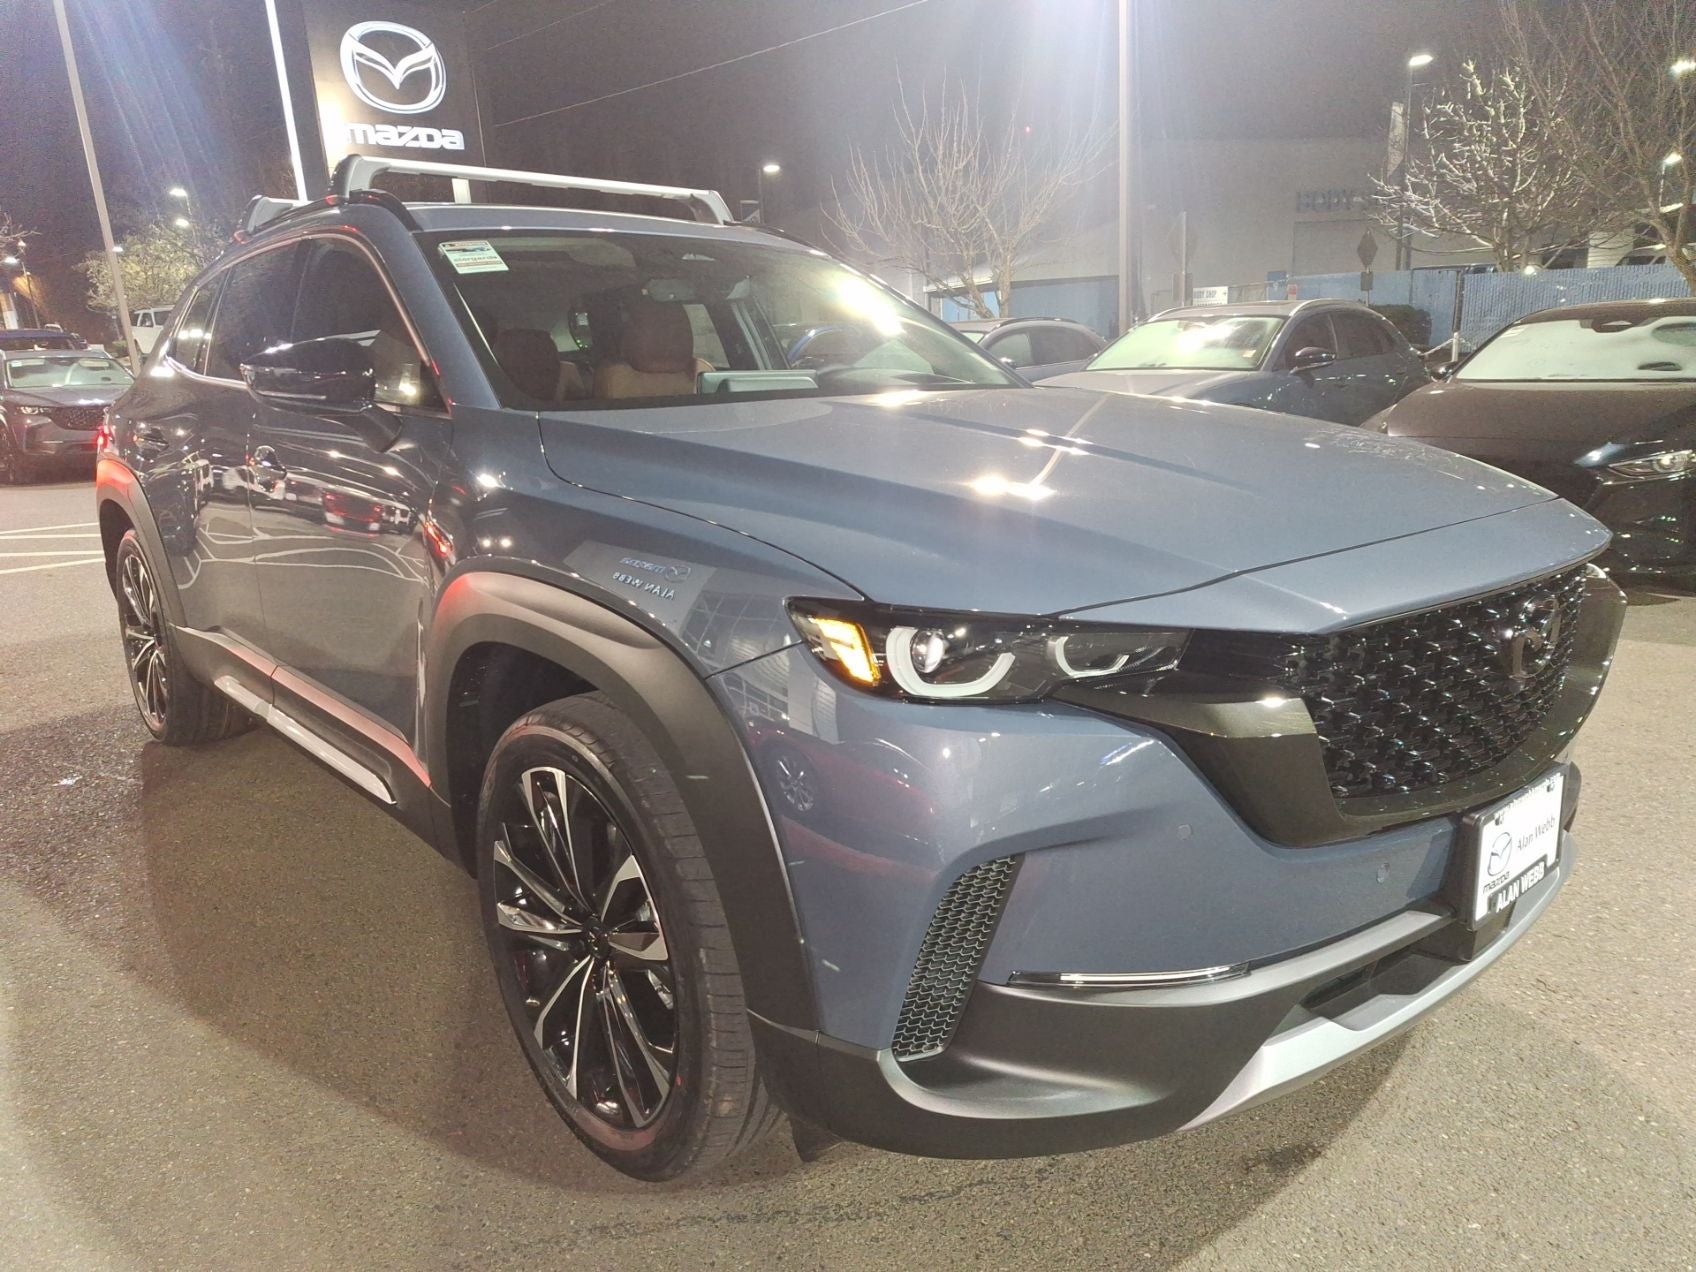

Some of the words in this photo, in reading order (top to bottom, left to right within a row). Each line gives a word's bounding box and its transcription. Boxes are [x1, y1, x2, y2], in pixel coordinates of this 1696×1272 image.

[1517, 834, 1534, 852] Alan
[1535, 816, 1556, 838] Webb
[1496, 879, 1520, 913] ALAN
[1521, 862, 1545, 894] WEBB
